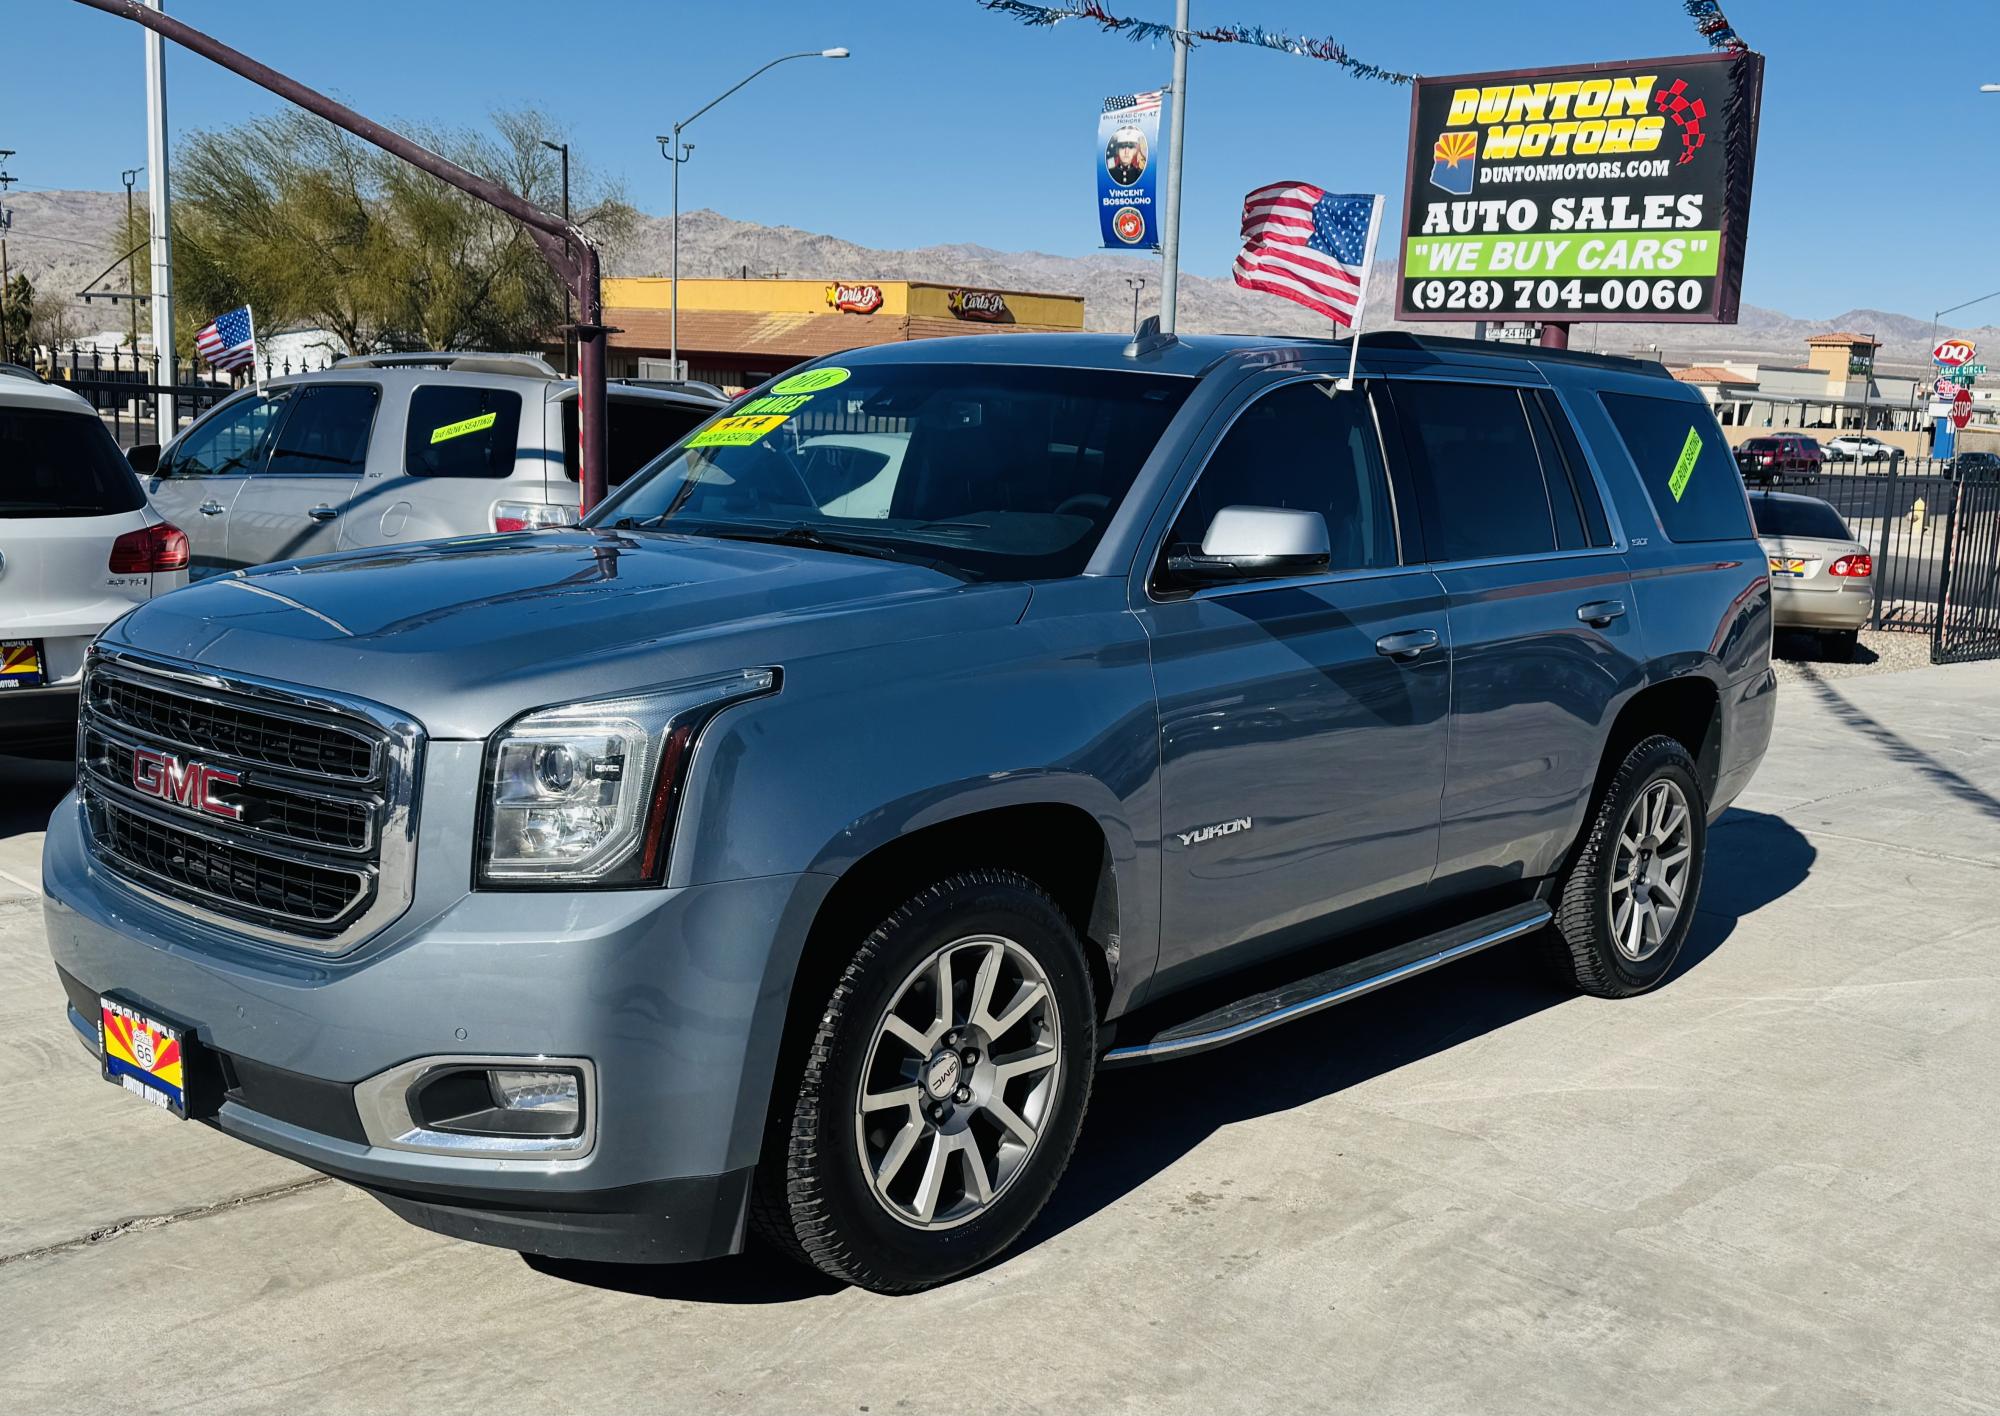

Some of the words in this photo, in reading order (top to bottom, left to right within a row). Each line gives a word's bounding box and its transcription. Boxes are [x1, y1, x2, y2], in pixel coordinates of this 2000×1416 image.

[1446, 76, 1658, 126] DUNTON
[1482, 116, 1666, 160] MOTORS
[1480, 159, 1670, 184] DUNTONMOTORS.COM
[1103, 197, 1151, 206] BOSSOLONO
[1109, 188, 1144, 198] VINCENT
[1421, 198, 1539, 233] AUTO
[1550, 194, 1704, 230] SALES
[1415, 242, 1483, 272] "WE
[1489, 241, 1572, 271] BUY
[1577, 238, 1708, 272] CARS"
[1412, 280, 1504, 310] (928)
[1513, 280, 1703, 310] 704-0060
[1940, 344, 1969, 362] DQ
[1941, 366, 1960, 375] AGATE
[1963, 365, 1986, 374] CIRCLE
[1953, 401, 1970, 417] STOP
[463, 416, 494, 431] SEATING
[1678, 460, 1689, 482] ROW
[1685, 431, 1700, 466] SEATING
[0, 679, 20, 688] OTORS
[595, 764, 620, 773] GMC
[133, 746, 244, 821] GMC
[1177, 816, 1252, 846] YUKON
[137, 1044, 152, 1063] 66
[932, 1061, 957, 1091] GMC
